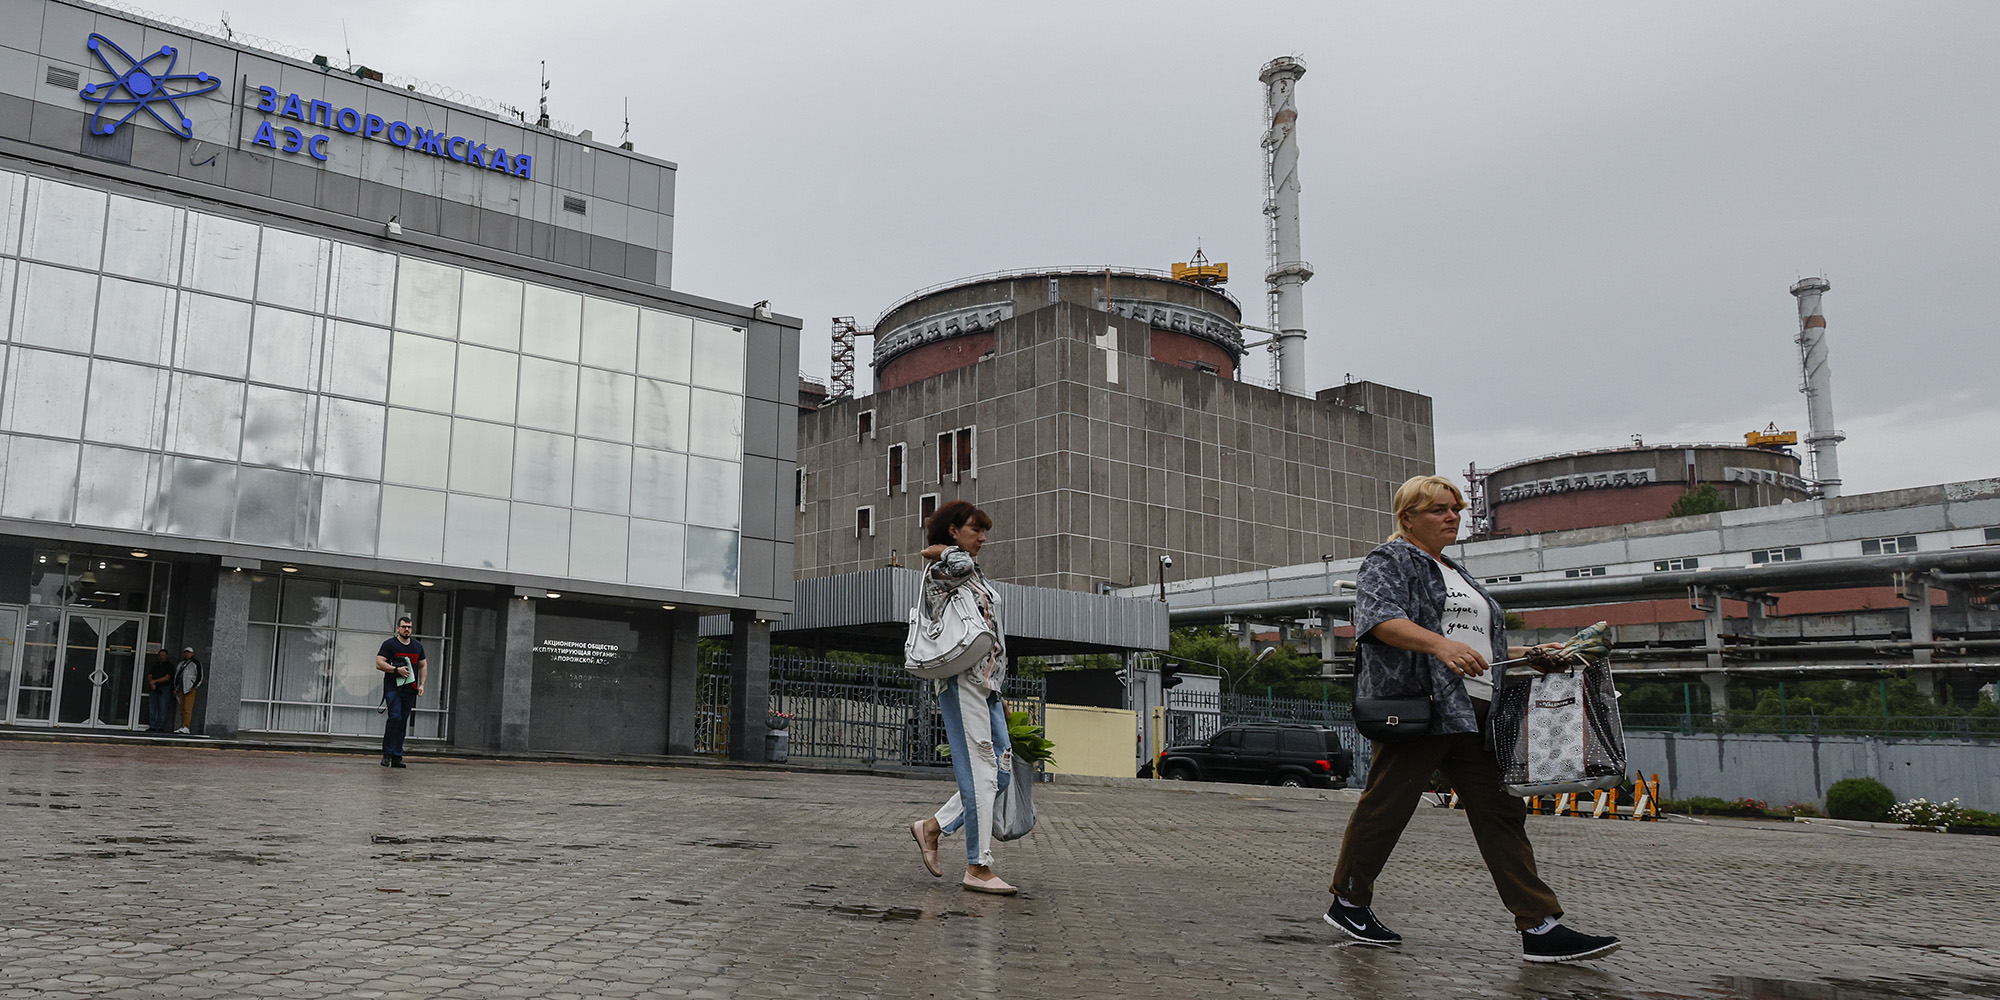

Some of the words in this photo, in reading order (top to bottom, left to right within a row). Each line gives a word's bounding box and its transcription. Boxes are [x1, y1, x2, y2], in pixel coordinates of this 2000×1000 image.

[252, 120, 330, 161] АЭС
[257, 85, 532, 179] ЗАПОРОЖСКАЯ
[1096, 325, 1118, 384] 1
[543, 639, 586, 649] АКЦИОНЕРНОЕ
[587, 643, 619, 651] ОБЩЕСТВО
[1446, 622, 1469, 634] you
